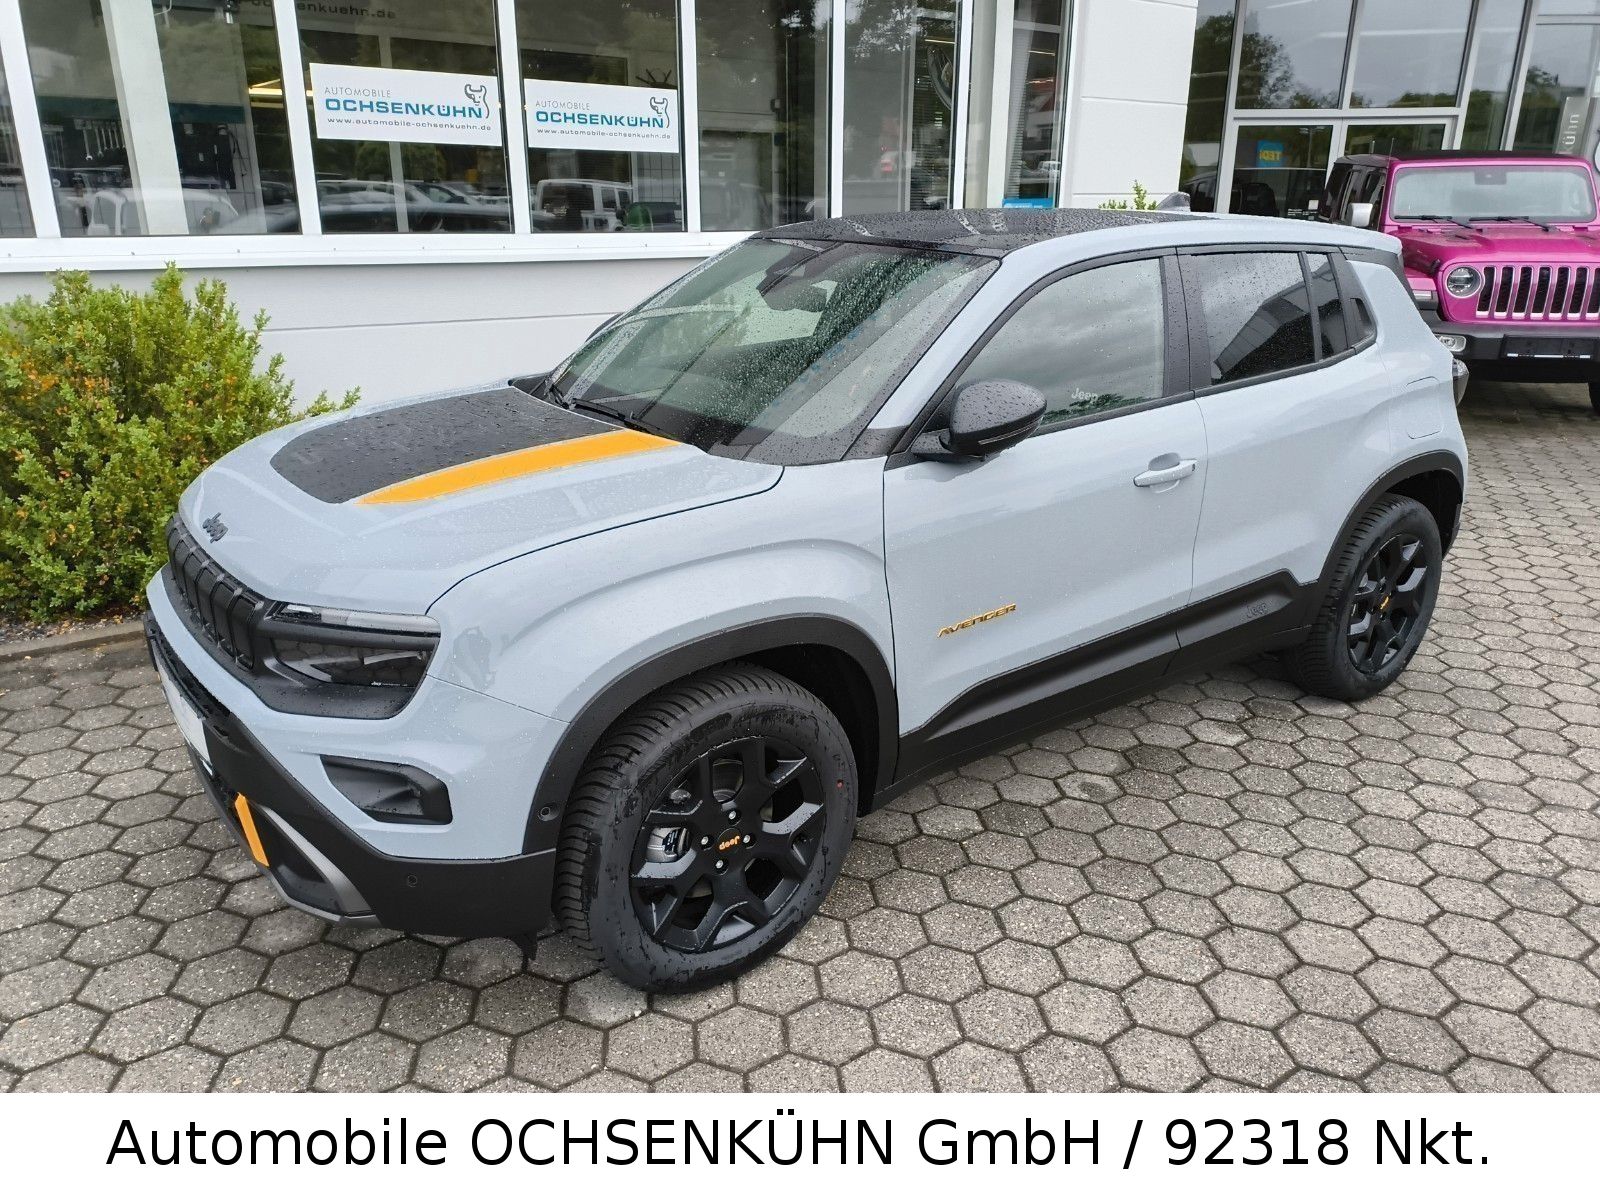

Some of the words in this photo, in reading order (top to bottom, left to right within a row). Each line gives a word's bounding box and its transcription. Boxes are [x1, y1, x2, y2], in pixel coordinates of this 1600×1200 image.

[324, 87, 391, 98] AUTOMOBILE
[325, 98, 483, 119] OCHSENKÜHN
[535, 100, 590, 111] AUTOMOBILE
[327, 117, 491, 131] www.automobile-ochsenkuehn.de
[536, 111, 664, 129] OCHSENKÜHN
[537, 128, 671, 140] www.automobile-ochsenkuehn.de
[1071, 387, 1098, 405] Jeep
[937, 603, 1017, 638] AVENGER
[719, 835, 740, 850] Jeep
